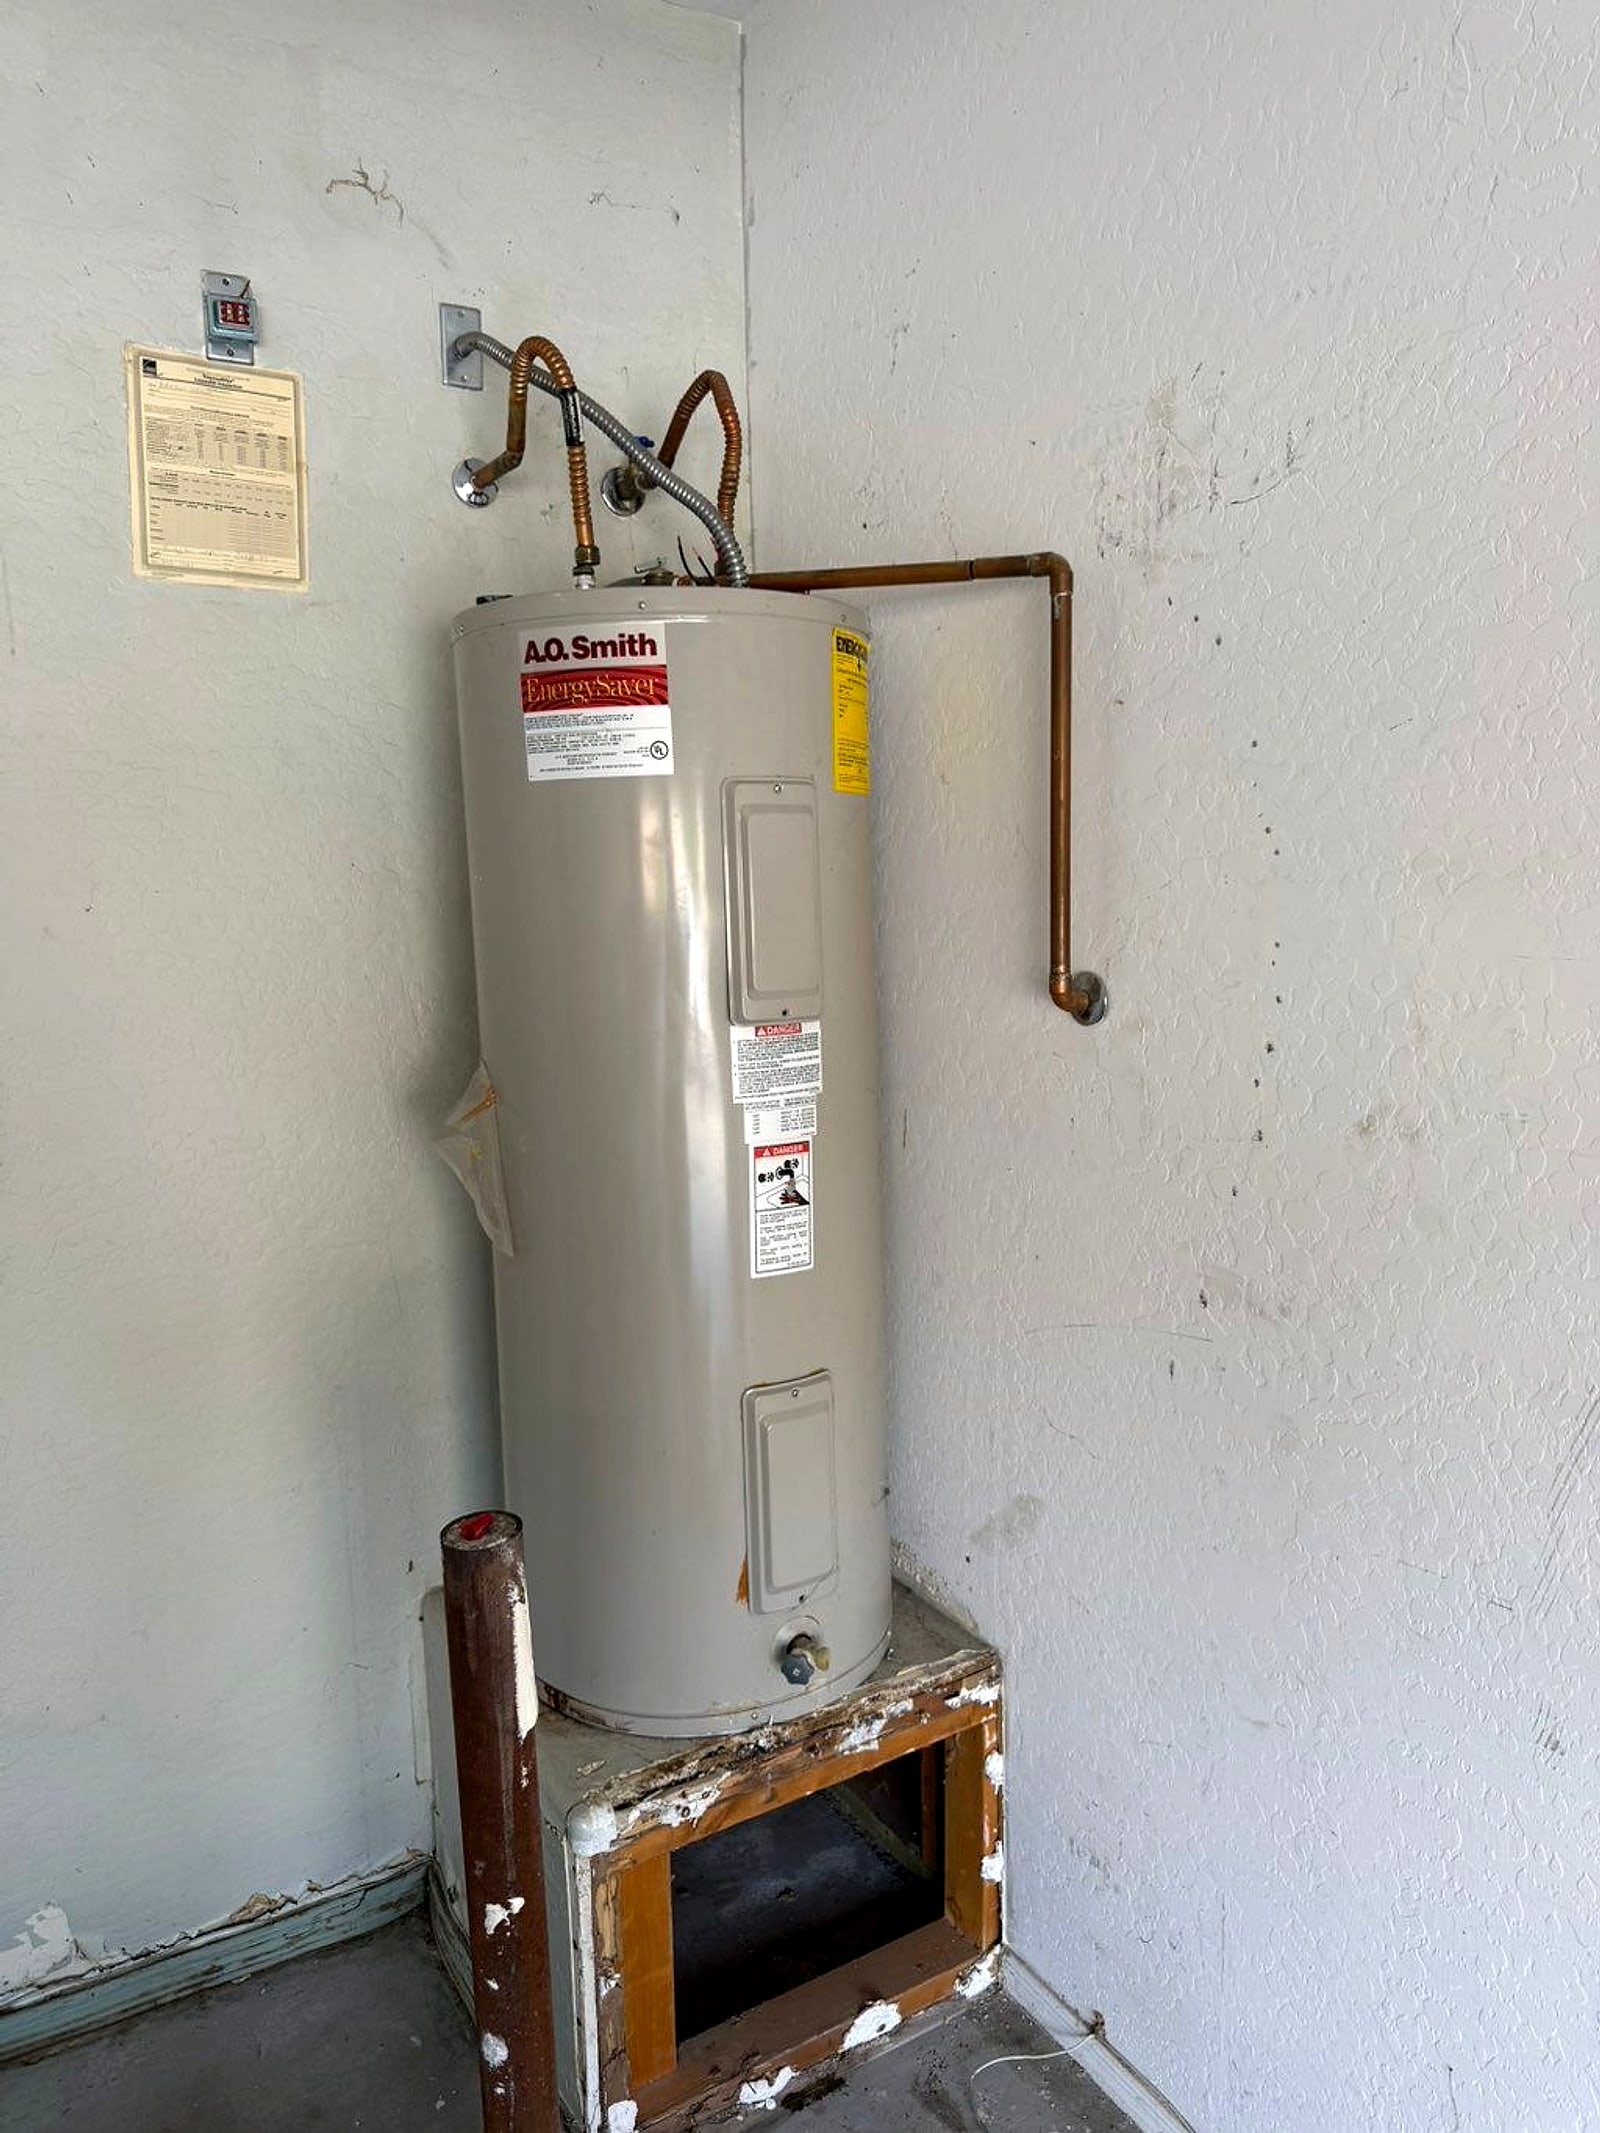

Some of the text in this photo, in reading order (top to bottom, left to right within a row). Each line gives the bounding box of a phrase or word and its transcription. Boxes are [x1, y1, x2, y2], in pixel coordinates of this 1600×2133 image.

[524, 633, 657, 664] A.O. Smith
[526, 674, 656, 704] EnergySaver
[773, 1143, 804, 1155] DANGER
